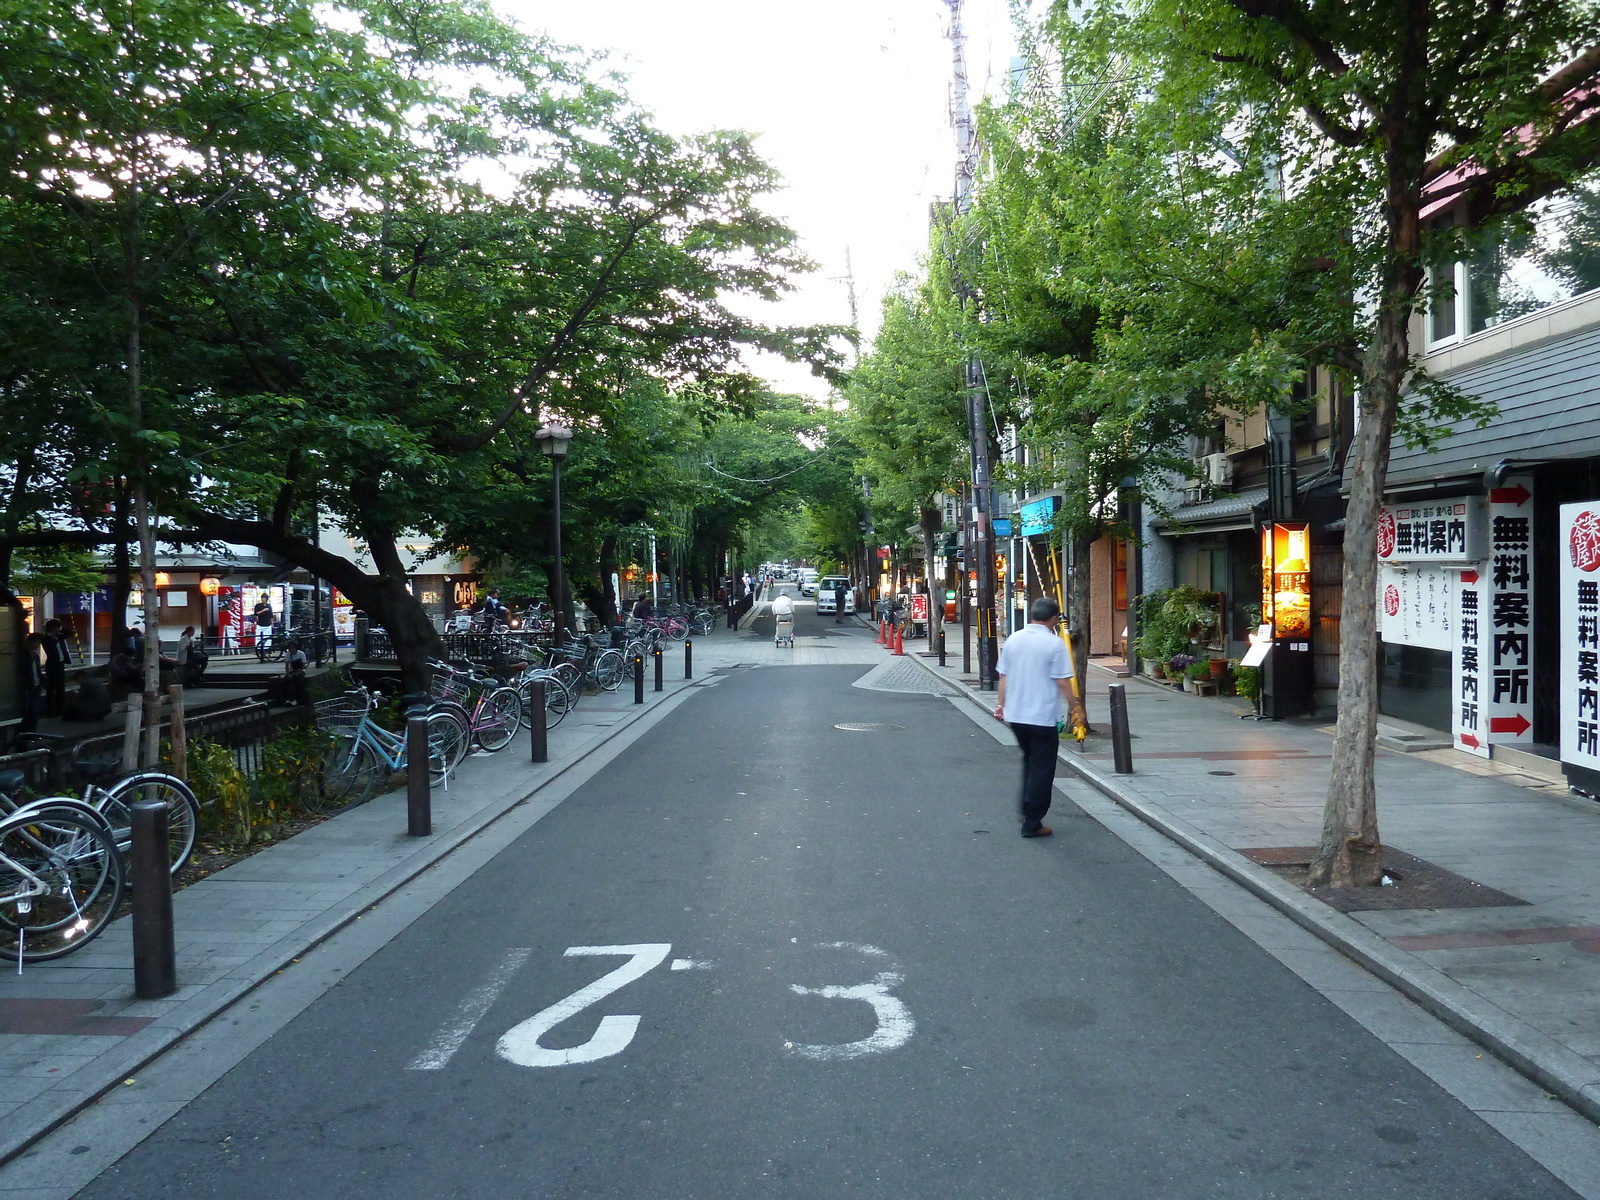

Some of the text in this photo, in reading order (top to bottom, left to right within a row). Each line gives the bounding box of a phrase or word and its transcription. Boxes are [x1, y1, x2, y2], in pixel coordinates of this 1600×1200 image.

[1397, 518, 1466, 554] 無料案内
[1436, 505, 1452, 517] 食べる
[1462, 589, 1478, 730] 無料案内所
[1493, 515, 1530, 704] 無料案内所
[1578, 579, 1599, 757] 無料案内所
